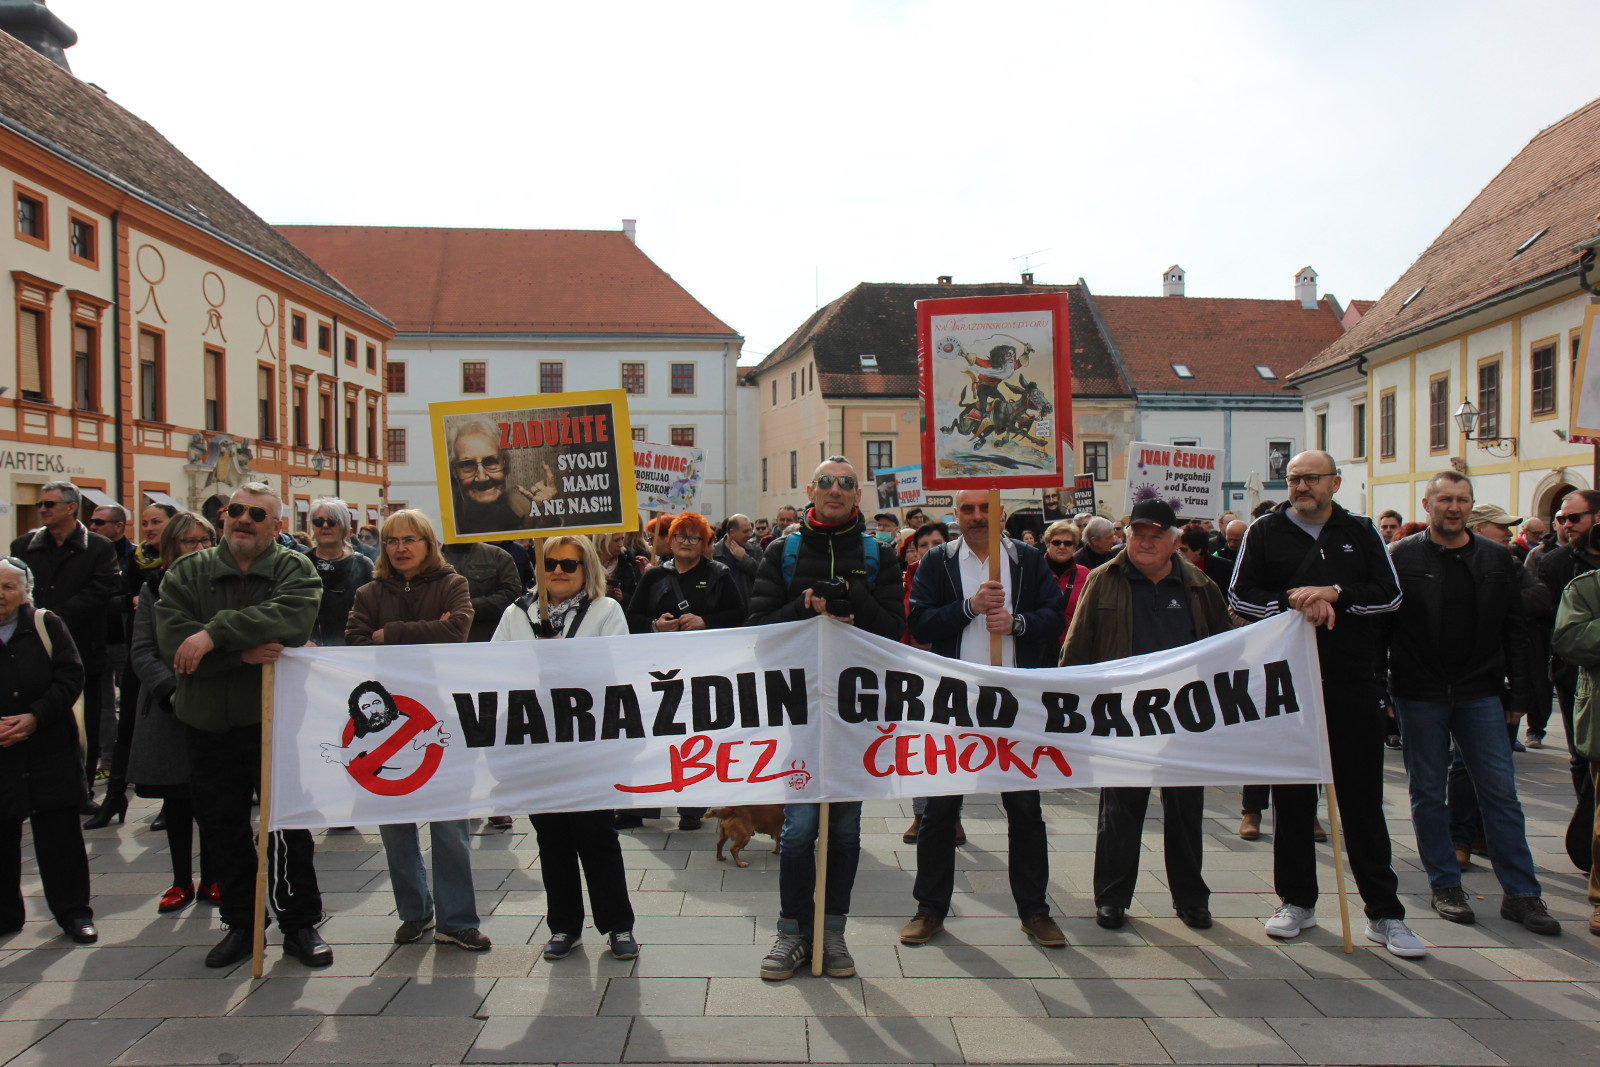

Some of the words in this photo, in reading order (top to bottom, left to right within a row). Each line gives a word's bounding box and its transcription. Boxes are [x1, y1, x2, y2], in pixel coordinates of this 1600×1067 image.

[946, 317, 1016, 331] VARAŽDINSKOM
[1017, 320, 1049, 329] DVORU
[498, 412, 608, 449] ZADUŽITE
[557, 451, 608, 471] SVOJU
[633, 451, 652, 468] NAŠ
[654, 454, 688, 472] NOVAC
[1140, 449, 1170, 466] IVAN
[1173, 449, 1216, 470] ČEHOK
[562, 473, 610, 493] MAMU
[901, 476, 917, 485] HDZ
[1165, 470, 1173, 480] je
[1174, 472, 1211, 483] pogubniji
[898, 489, 920, 500] LJUBAV
[1074, 491, 1092, 499] SVOJU
[1170, 483, 1180, 492] od
[1181, 484, 1210, 494] Korona
[529, 500, 541, 517] A
[543, 498, 566, 516] NE
[567, 496, 613, 514] NAS!!!
[927, 497, 951, 505] SHOP
[1184, 496, 1209, 506] virusa
[452, 669, 809, 748] VARAŽDIN
[838, 667, 1020, 728] GRAD
[1042, 659, 1301, 737] BAROKA
[862, 722, 1073, 778] ČEHOKA
